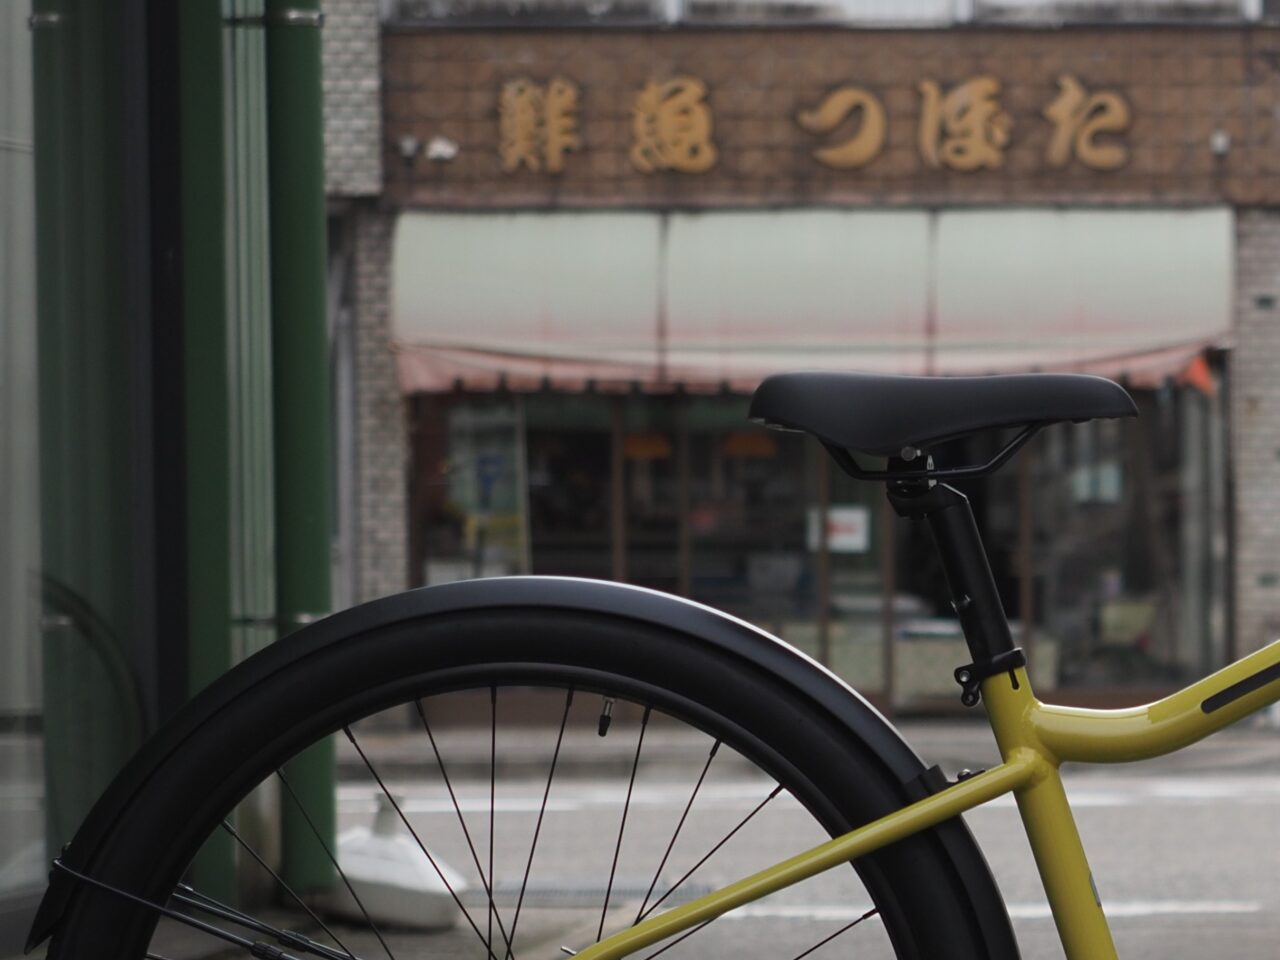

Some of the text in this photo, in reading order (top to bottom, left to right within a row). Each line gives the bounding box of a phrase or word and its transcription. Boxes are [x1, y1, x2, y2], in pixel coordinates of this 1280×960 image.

[501, 74, 1131, 174] 鮮魚 つぼた
